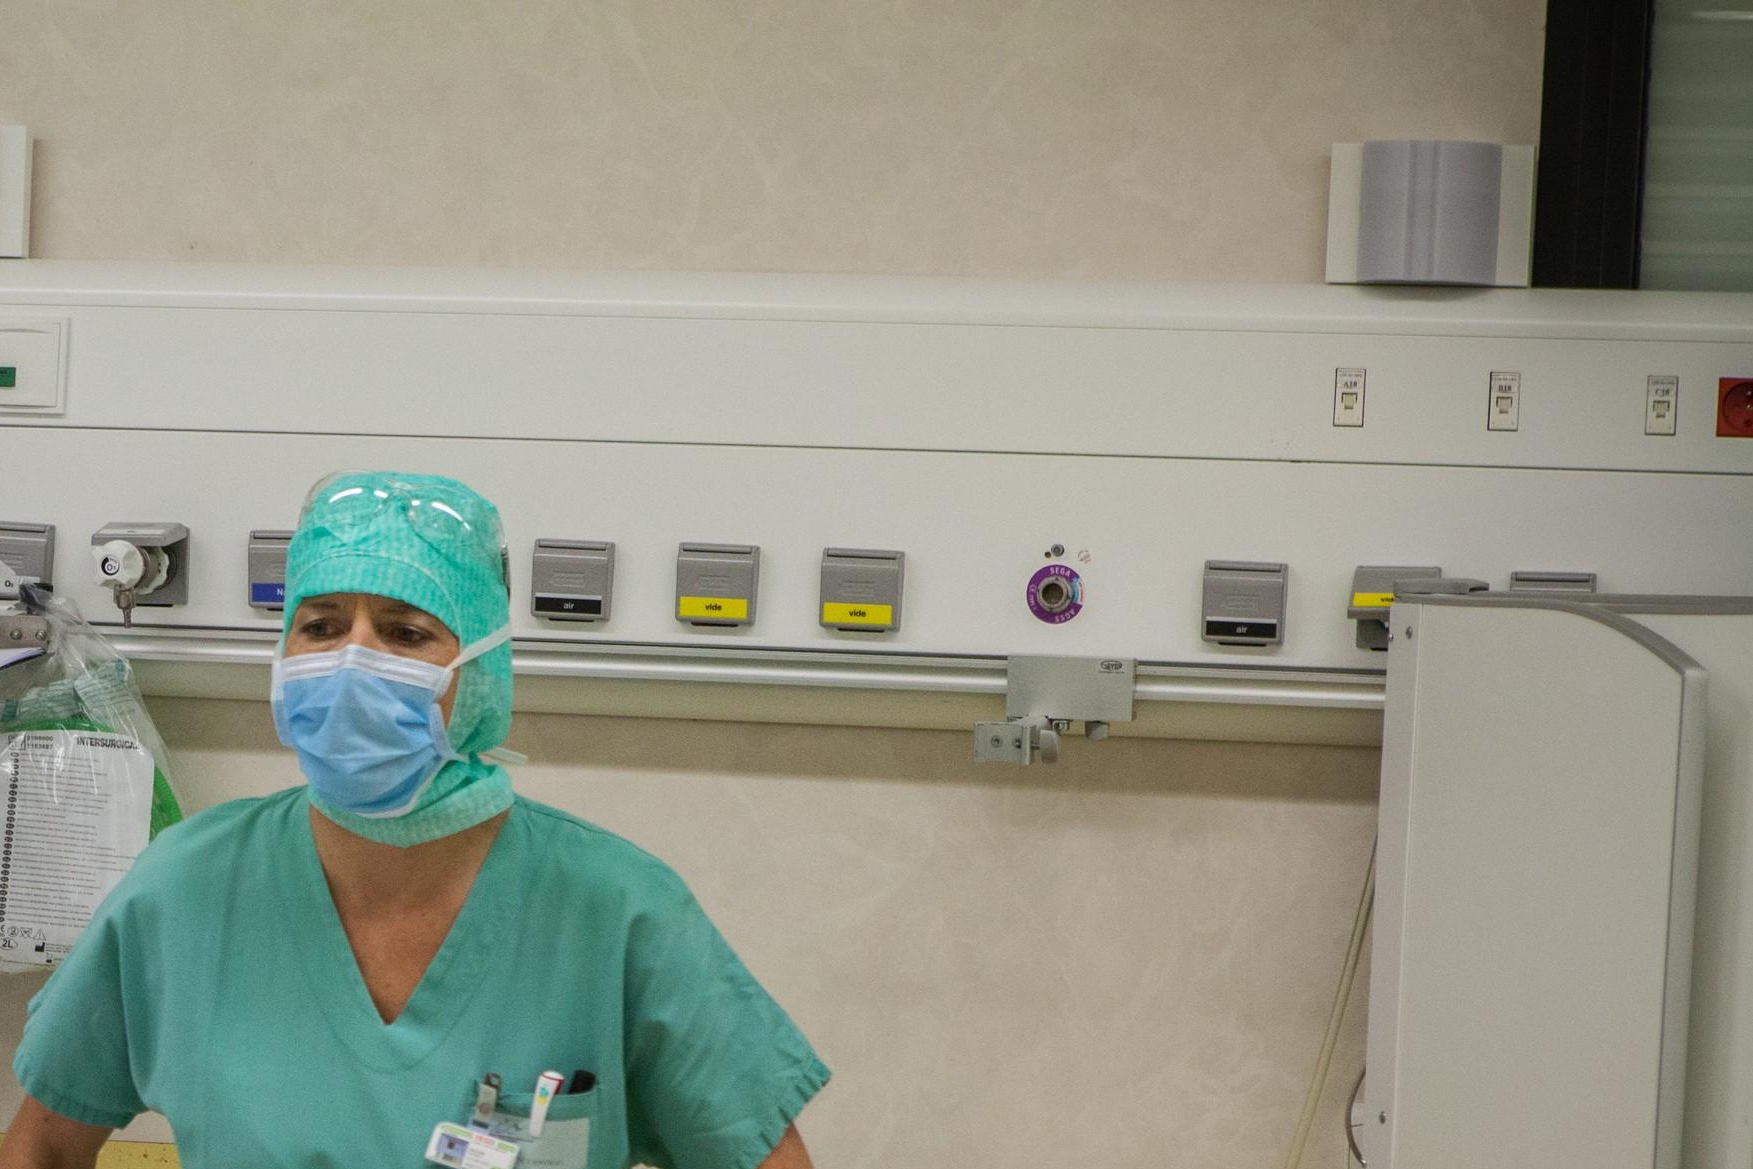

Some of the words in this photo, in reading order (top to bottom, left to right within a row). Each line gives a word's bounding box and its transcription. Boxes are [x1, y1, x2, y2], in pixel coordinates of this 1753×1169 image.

[563, 601, 575, 609] air
[705, 603, 723, 611] vide
[849, 610, 866, 618] vide
[1236, 625, 1248, 633] air
[76, 736, 138, 750] INTERSURGICA
[1, 938, 13, 948] 2L
